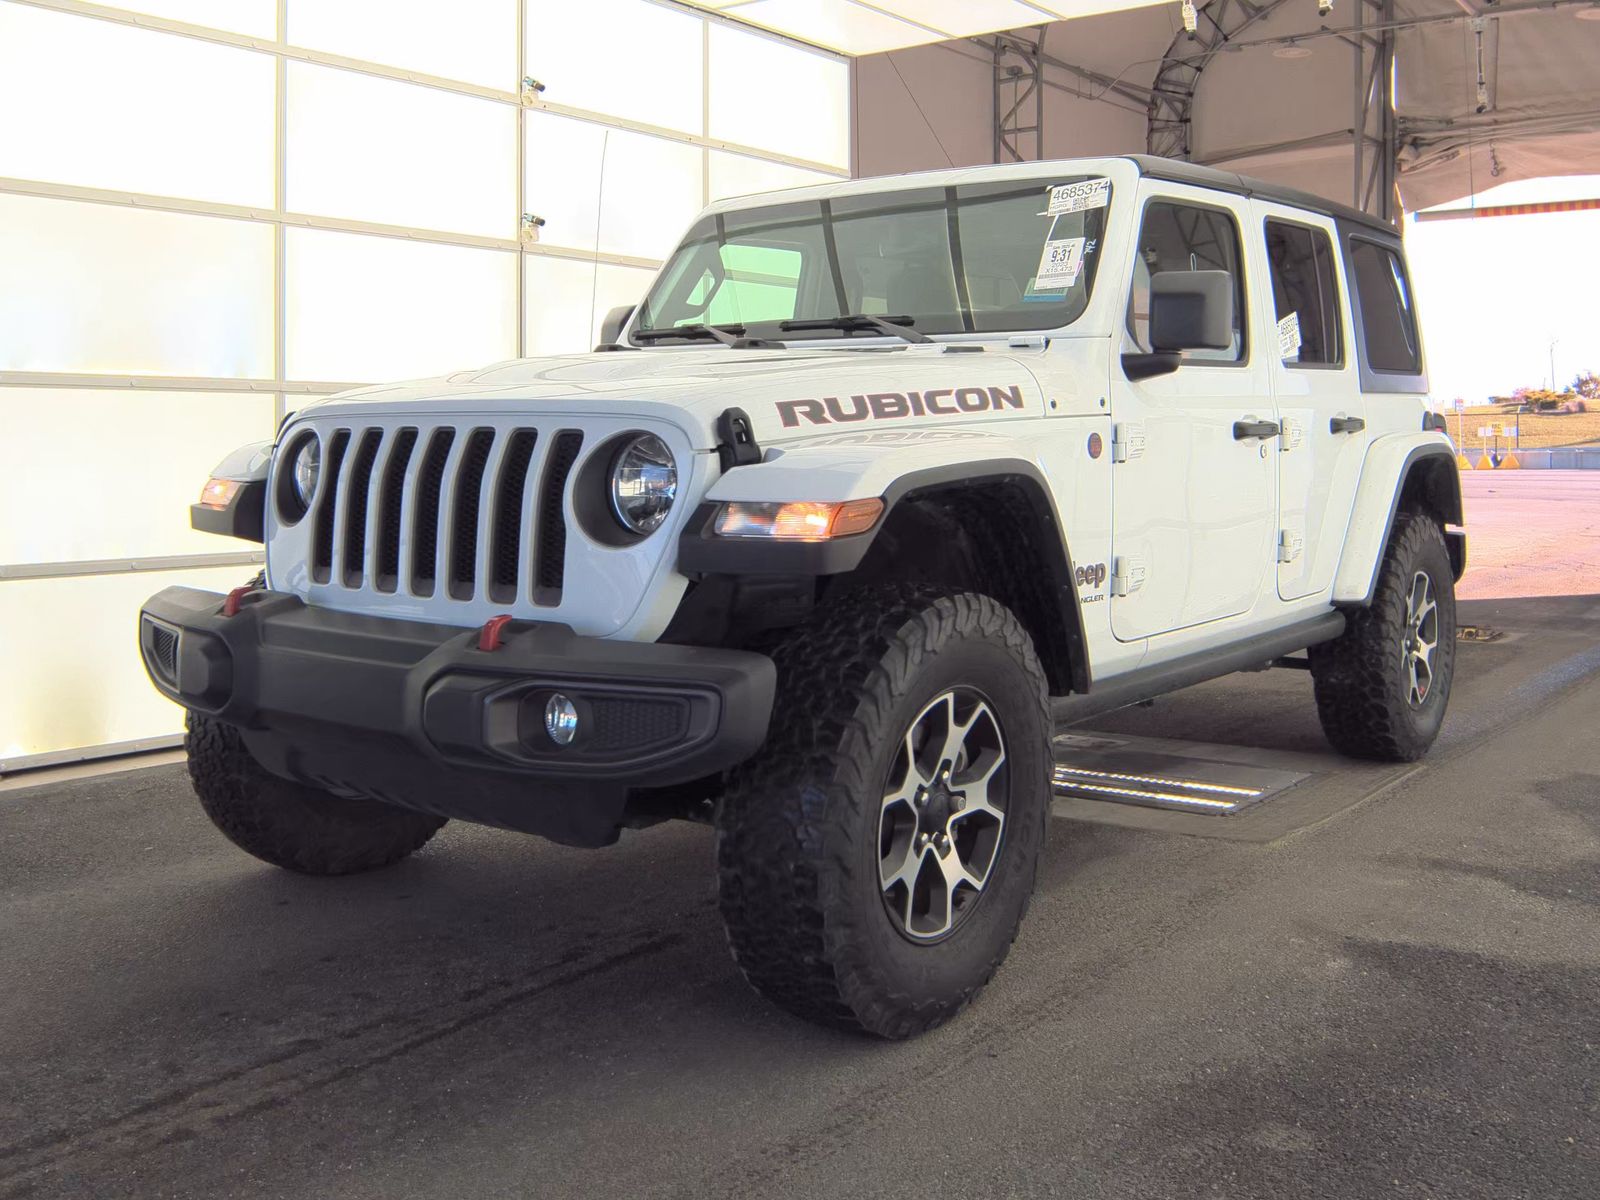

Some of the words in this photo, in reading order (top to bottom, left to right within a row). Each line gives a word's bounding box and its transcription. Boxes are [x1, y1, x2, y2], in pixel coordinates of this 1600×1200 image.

[1053, 180, 1109, 201] 4685374
[1051, 249, 1072, 262] 9:31
[775, 385, 1025, 428] RUBICON
[1073, 561, 1106, 589] eep
[1081, 594, 1104, 604] NGLER
